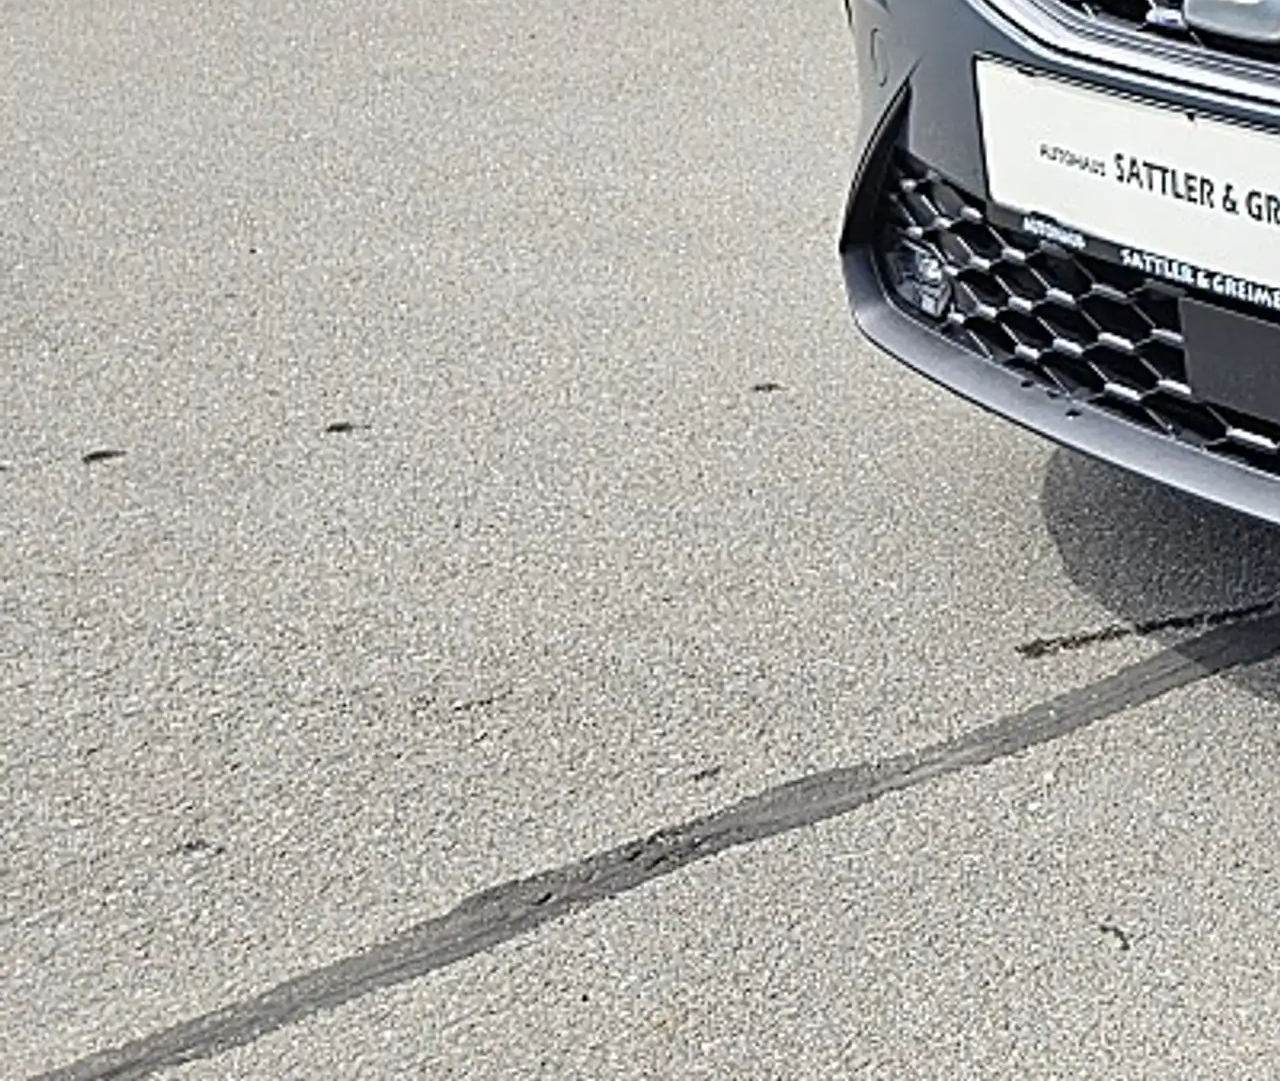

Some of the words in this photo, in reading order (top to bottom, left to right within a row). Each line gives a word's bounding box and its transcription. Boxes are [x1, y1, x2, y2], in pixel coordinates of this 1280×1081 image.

[1039, 143, 1106, 177] AUTOHAUS
[1113, 151, 1215, 209] SATTLER
[1222, 182, 1239, 215] &
[1120, 248, 1194, 284] SATTLER
[1196, 270, 1211, 289] &
